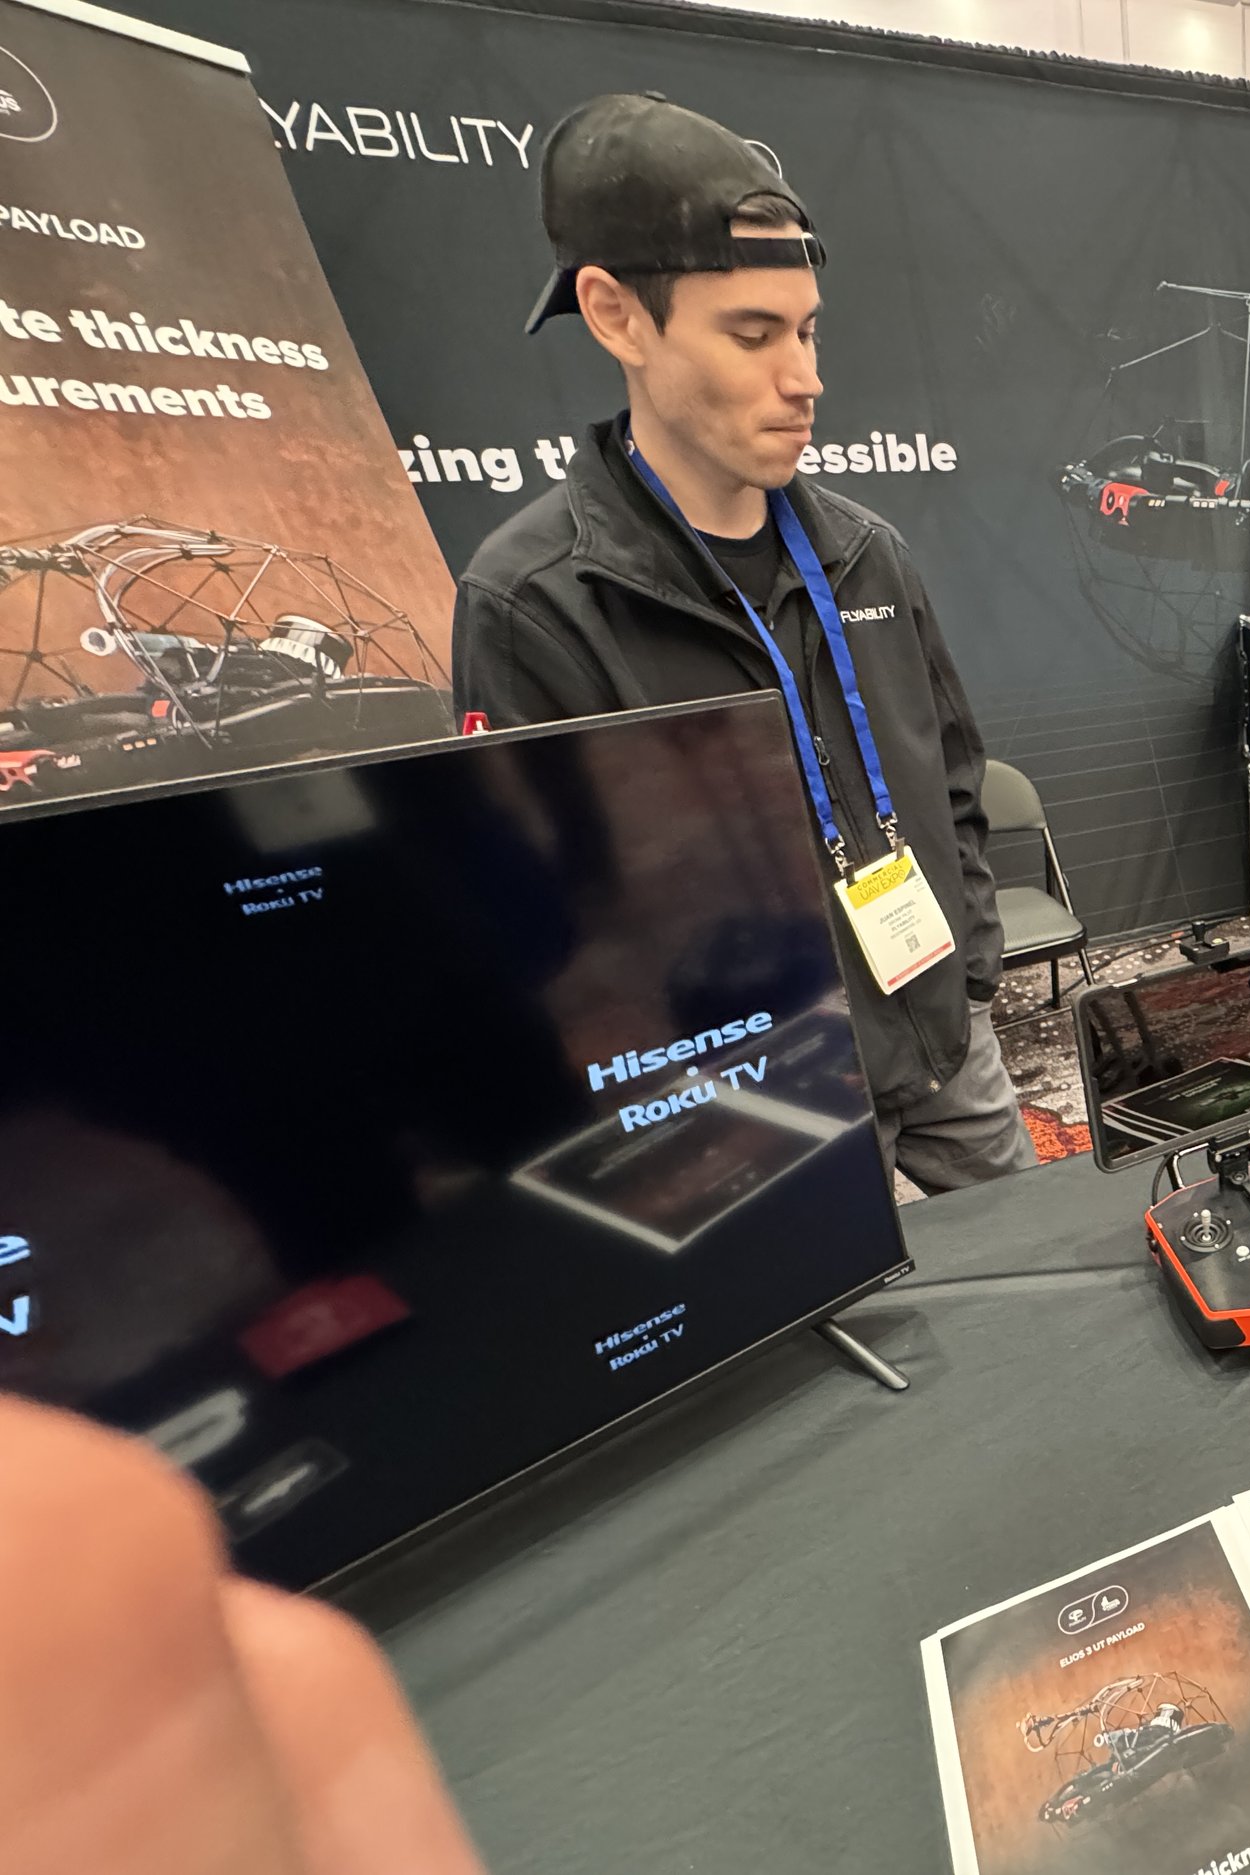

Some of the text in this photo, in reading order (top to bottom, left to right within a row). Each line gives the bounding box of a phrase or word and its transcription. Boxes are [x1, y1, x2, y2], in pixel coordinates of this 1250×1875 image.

[258, 97, 533, 169] YABILITY
[69, 309, 329, 371] thickness
[840, 604, 896, 623] FLYABILITY
[223, 864, 324, 895] Hisense
[857, 861, 902, 891] COMMERCIAL
[859, 884, 881, 901] UAV
[880, 869, 907, 890] EXPO
[241, 887, 325, 916] Roku TV
[586, 1010, 773, 1093] Hisense
[618, 1055, 769, 1133] Roku TV
[594, 1302, 687, 1356] Hisense
[608, 1323, 685, 1371] Roku TV
[1059, 1622, 1145, 1668] ELIOS 3 UT PAYLOAD
